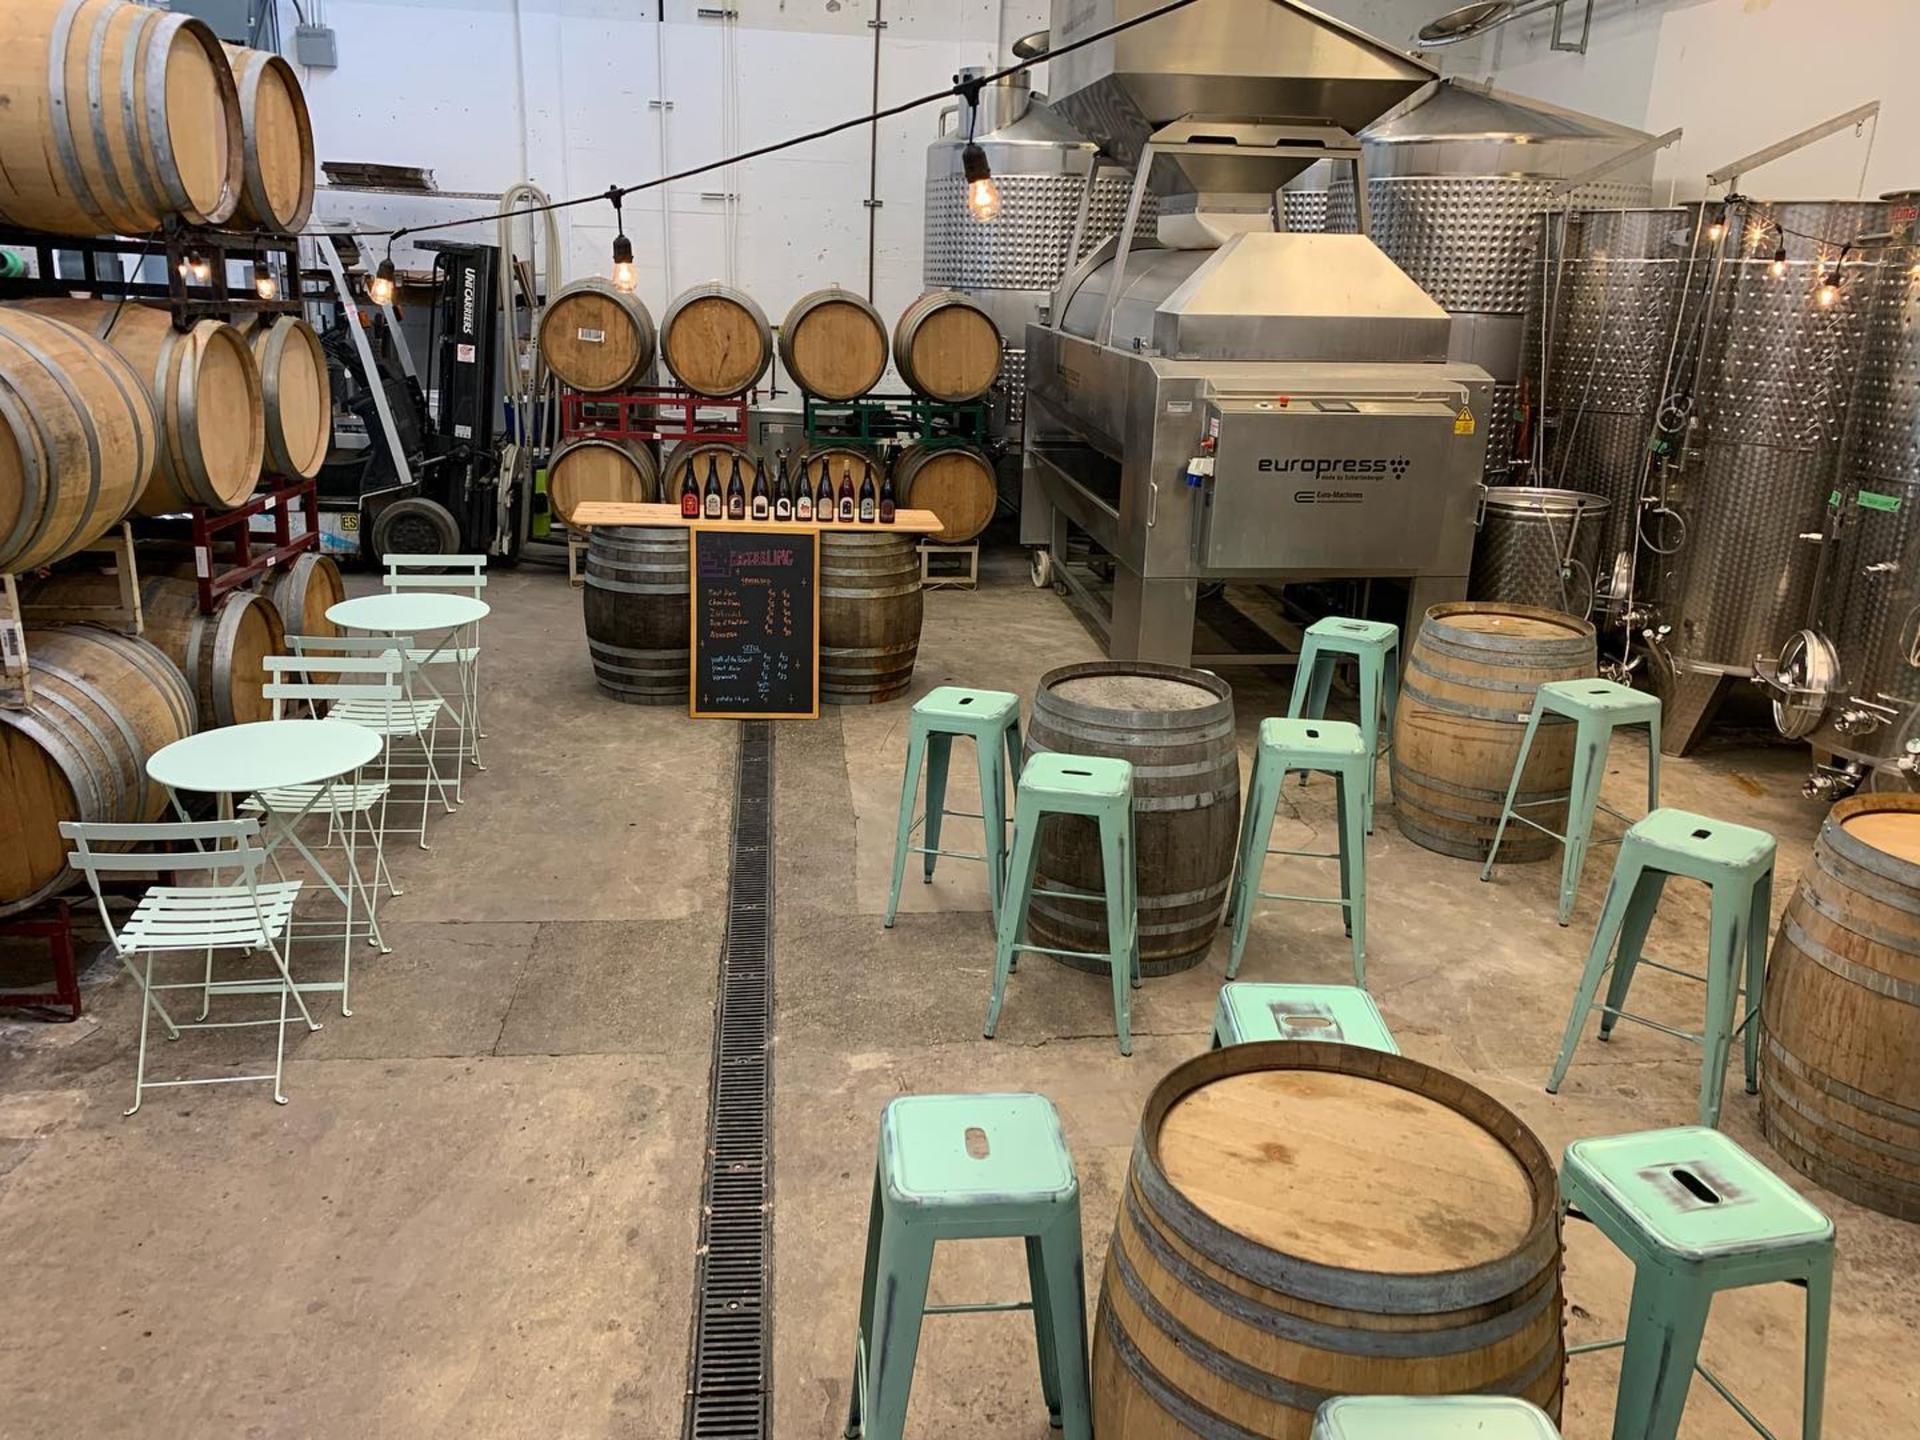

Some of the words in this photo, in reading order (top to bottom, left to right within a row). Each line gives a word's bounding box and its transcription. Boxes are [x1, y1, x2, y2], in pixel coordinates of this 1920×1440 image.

[462, 267, 476, 336] UNICARRIERS
[1257, 459, 1387, 480] europress
[342, 516, 357, 529] ES
